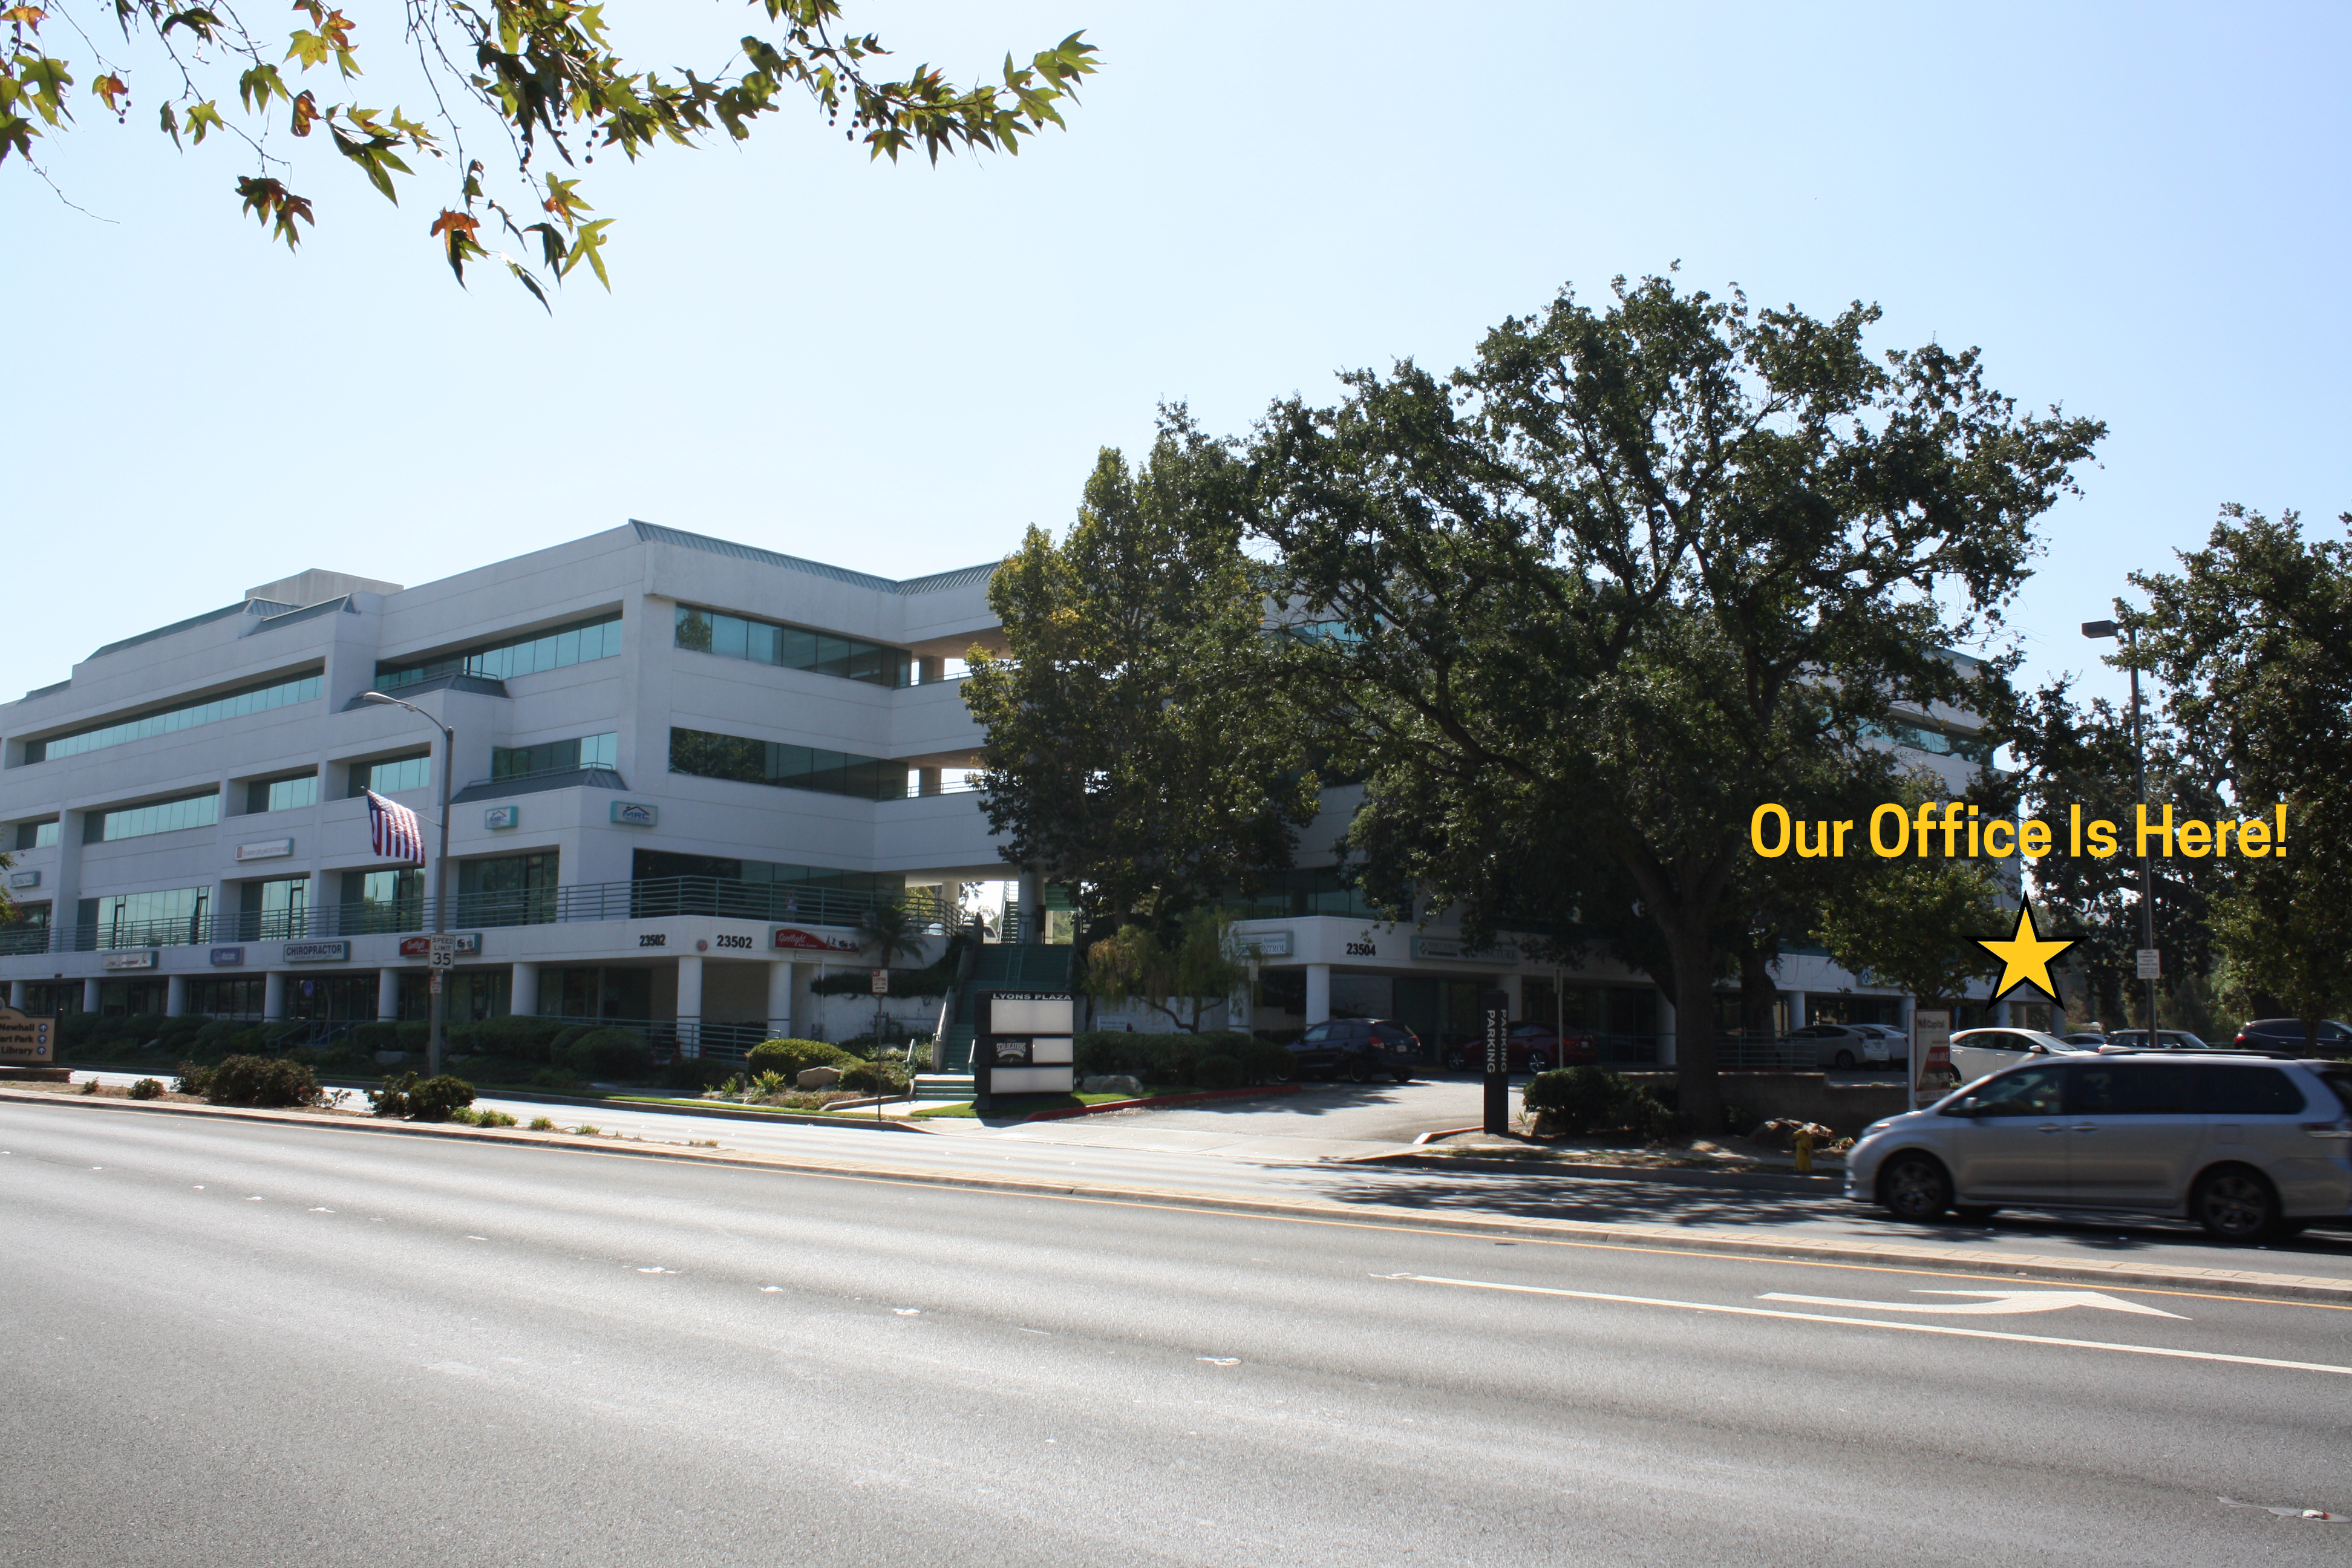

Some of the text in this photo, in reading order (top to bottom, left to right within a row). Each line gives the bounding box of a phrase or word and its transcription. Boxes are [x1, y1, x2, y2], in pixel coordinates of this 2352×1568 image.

[622, 811, 650, 820] MRC
[639, 933, 666, 947] 23502
[716, 934, 753, 949] 23502
[286, 944, 342, 956] CHIROPRACTOR
[1346, 942, 1376, 956] 23504
[433, 952, 451, 965] 35
[0, 1023, 35, 1031] Newhall
[15, 1034, 34, 1043] Park
[1487, 1010, 1495, 1073] PARKING
[1, 1046, 33, 1056] Library
